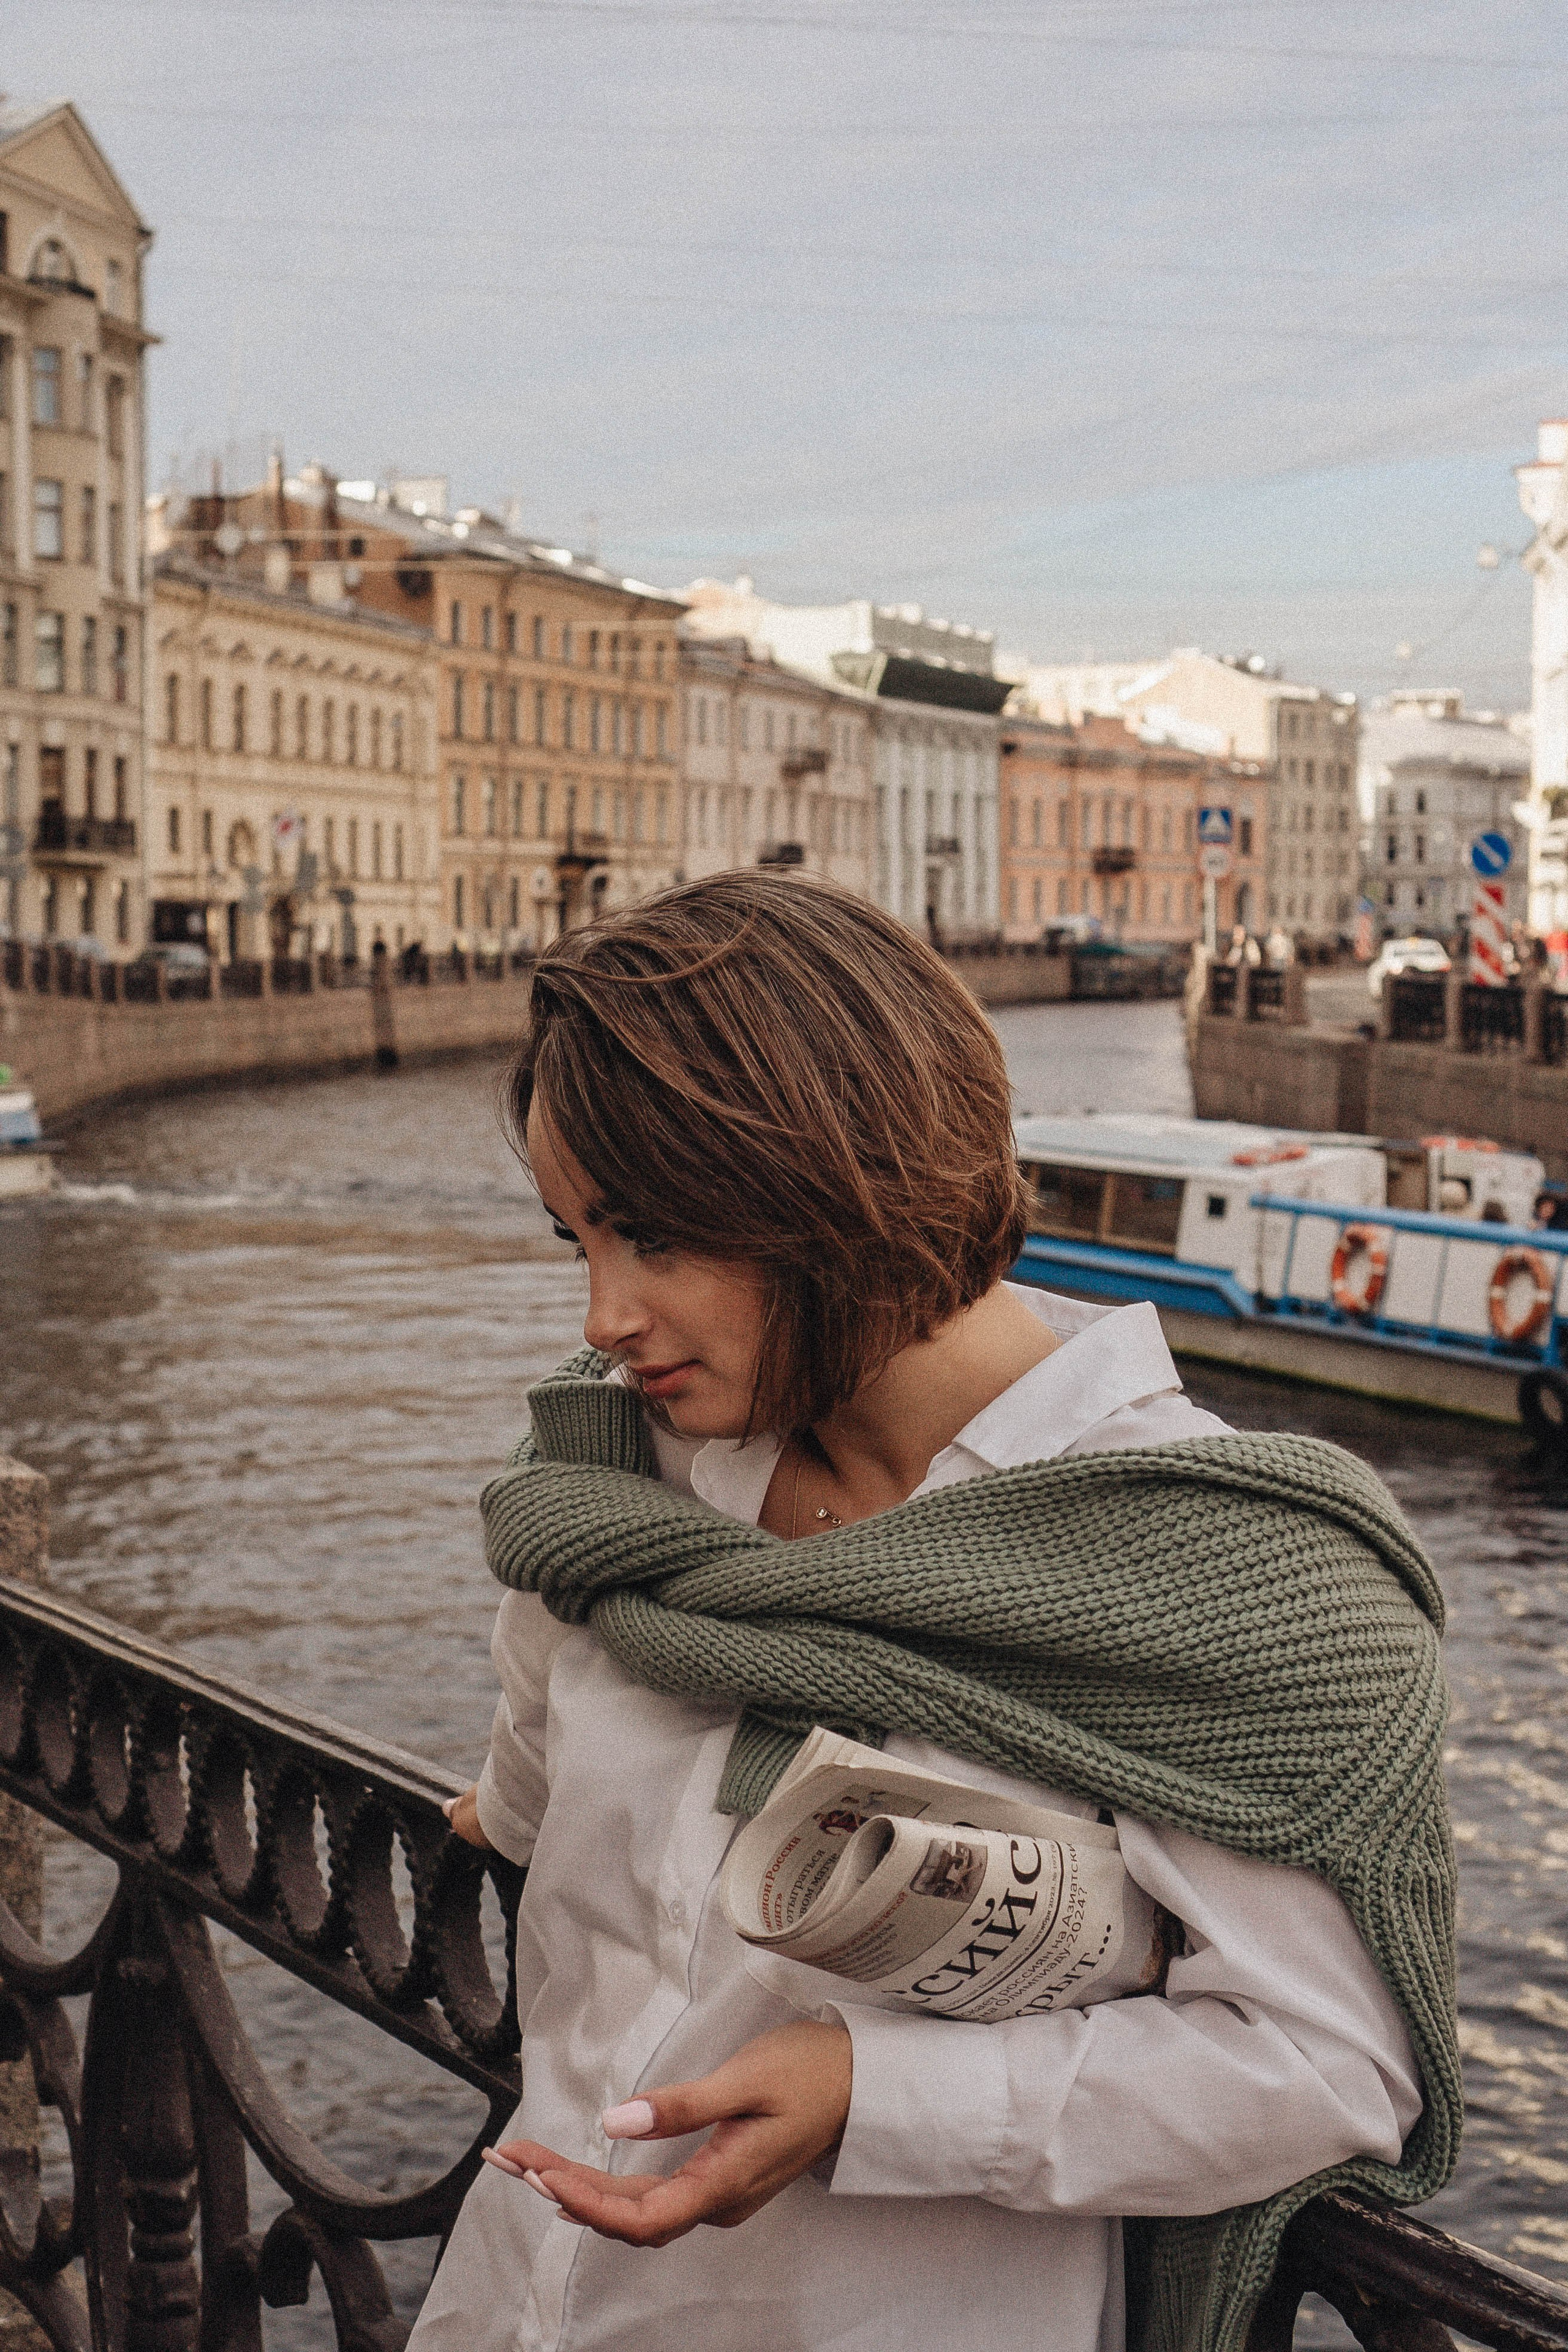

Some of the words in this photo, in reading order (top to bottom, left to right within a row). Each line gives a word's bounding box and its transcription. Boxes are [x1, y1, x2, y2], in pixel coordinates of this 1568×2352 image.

[763, 1883, 773, 1930] мпион
[787, 1849, 826, 1924] отыграться
[881, 1837, 1042, 2003] СИЙС
[995, 1887, 1088, 2007] Олимпиаду-2024?
[998, 1951, 1053, 1996] россиян
[1051, 1931, 1068, 1948] на
